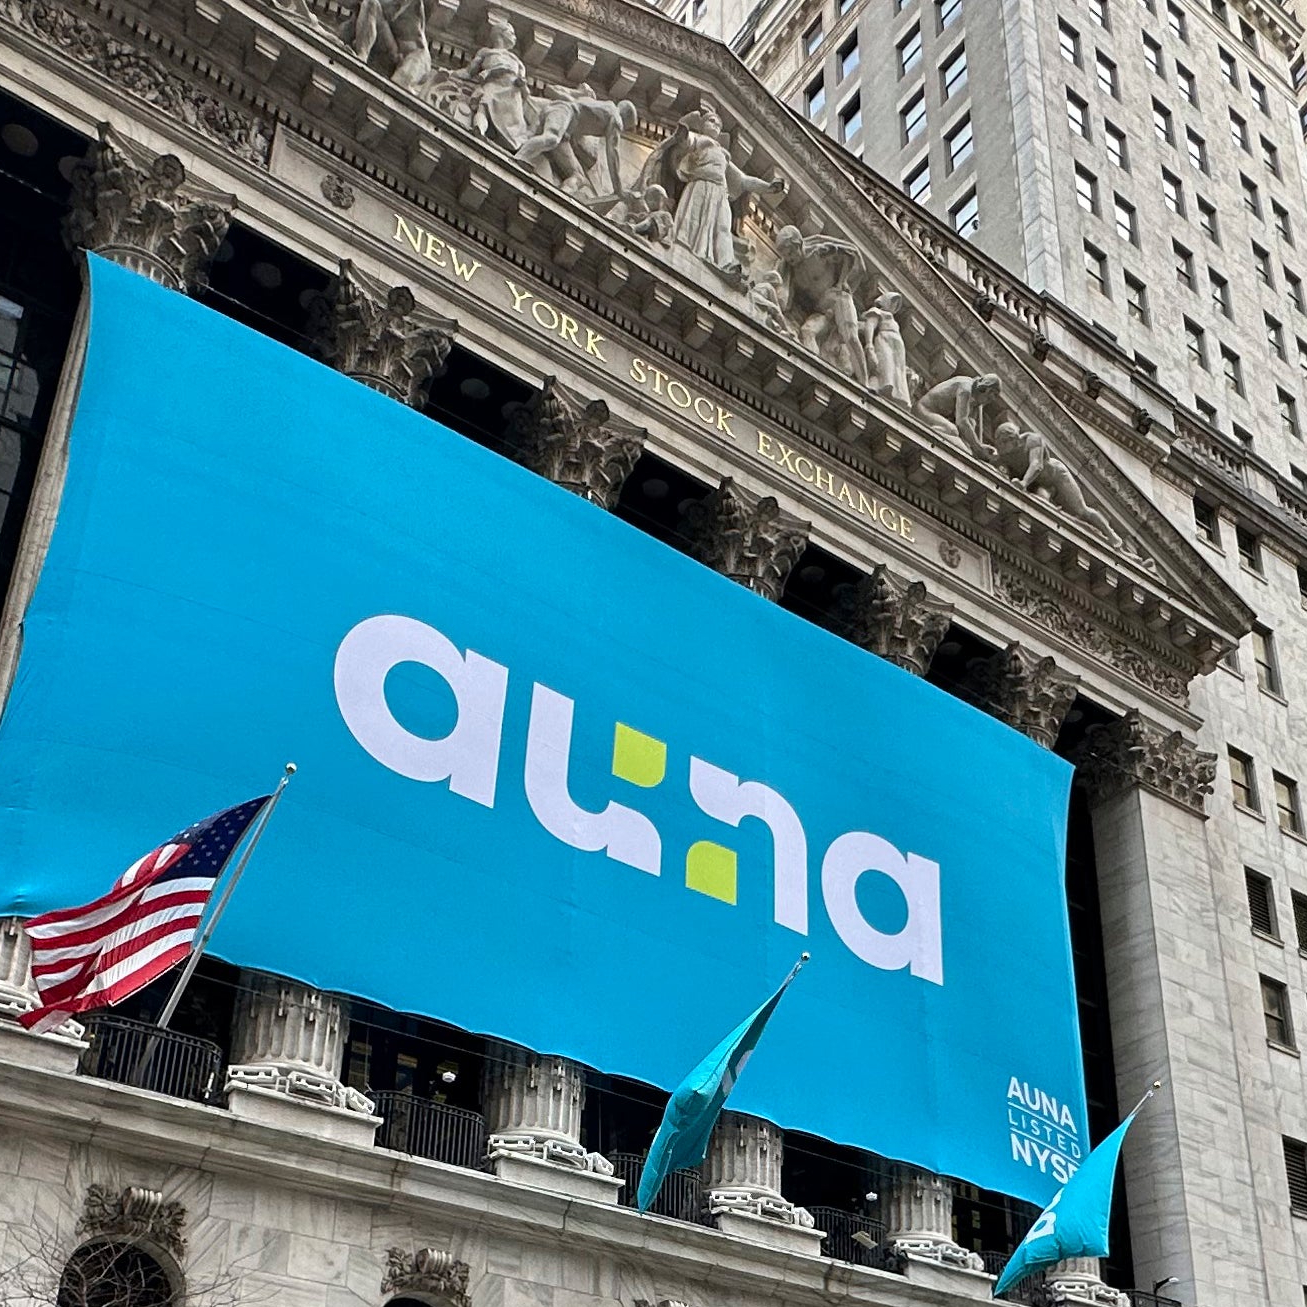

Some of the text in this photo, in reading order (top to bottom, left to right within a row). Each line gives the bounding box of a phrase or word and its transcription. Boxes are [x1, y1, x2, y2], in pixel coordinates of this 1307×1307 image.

[393, 213, 916, 543] NEW YORK STOCK EXCHANGE
[334, 614, 943, 986] auna
[1007, 1076, 1077, 1134] AUNA
[1008, 1108, 1081, 1159] LISTED
